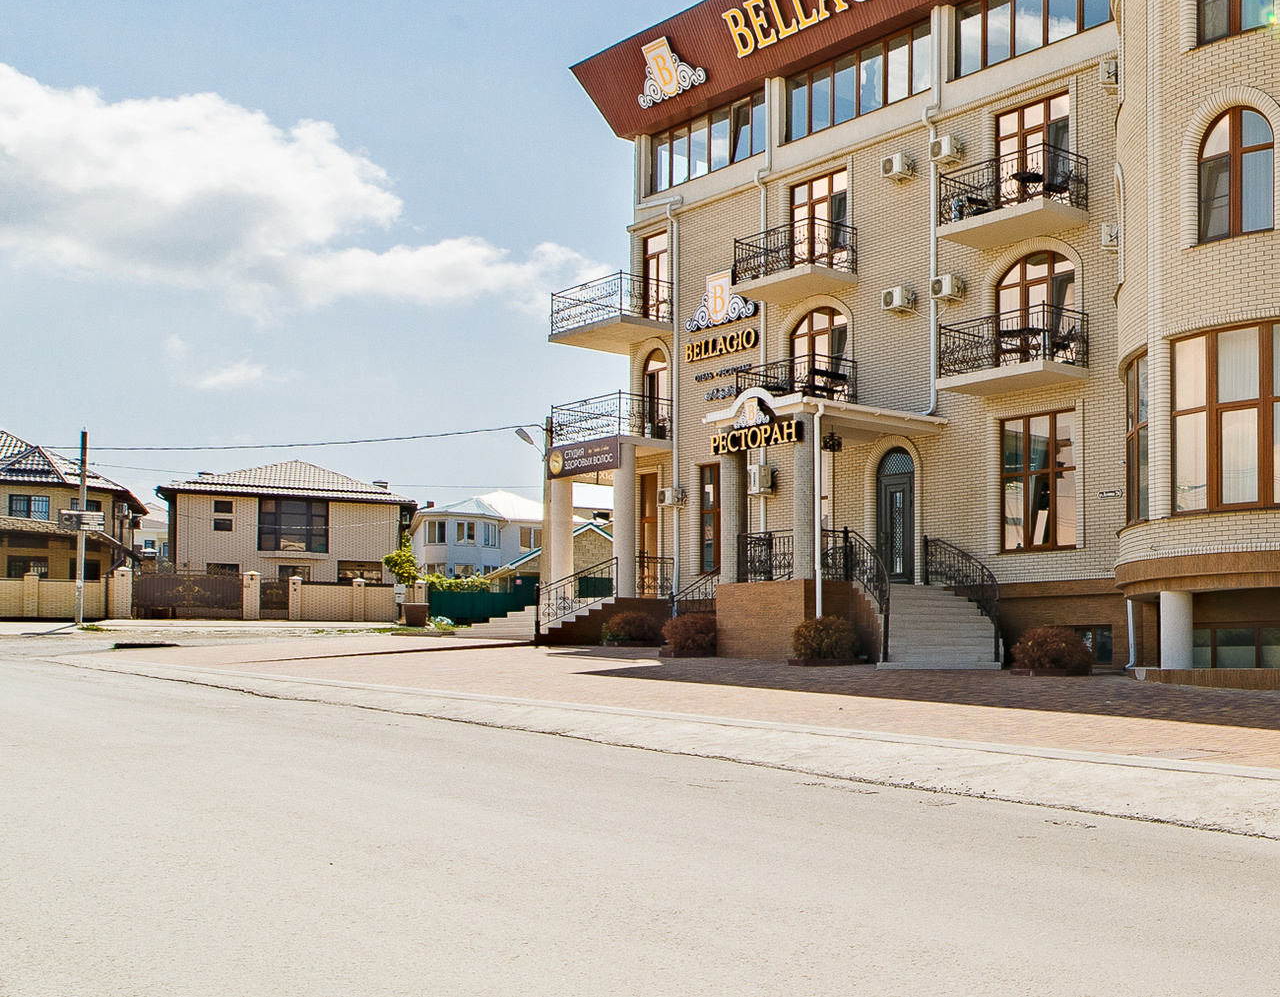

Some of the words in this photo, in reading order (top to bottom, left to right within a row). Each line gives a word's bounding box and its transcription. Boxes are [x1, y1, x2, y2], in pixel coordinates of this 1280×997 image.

[652, 54, 673, 86] B
[712, 284, 725, 314] B
[685, 327, 756, 363] BELLAGIO
[564, 447, 585, 459] СТУДИЯ
[710, 420, 797, 455] РЕСТОРАН
[564, 456, 593, 470] ЗДОРОВЫХ
[593, 453, 613, 465] ВОЛОС
